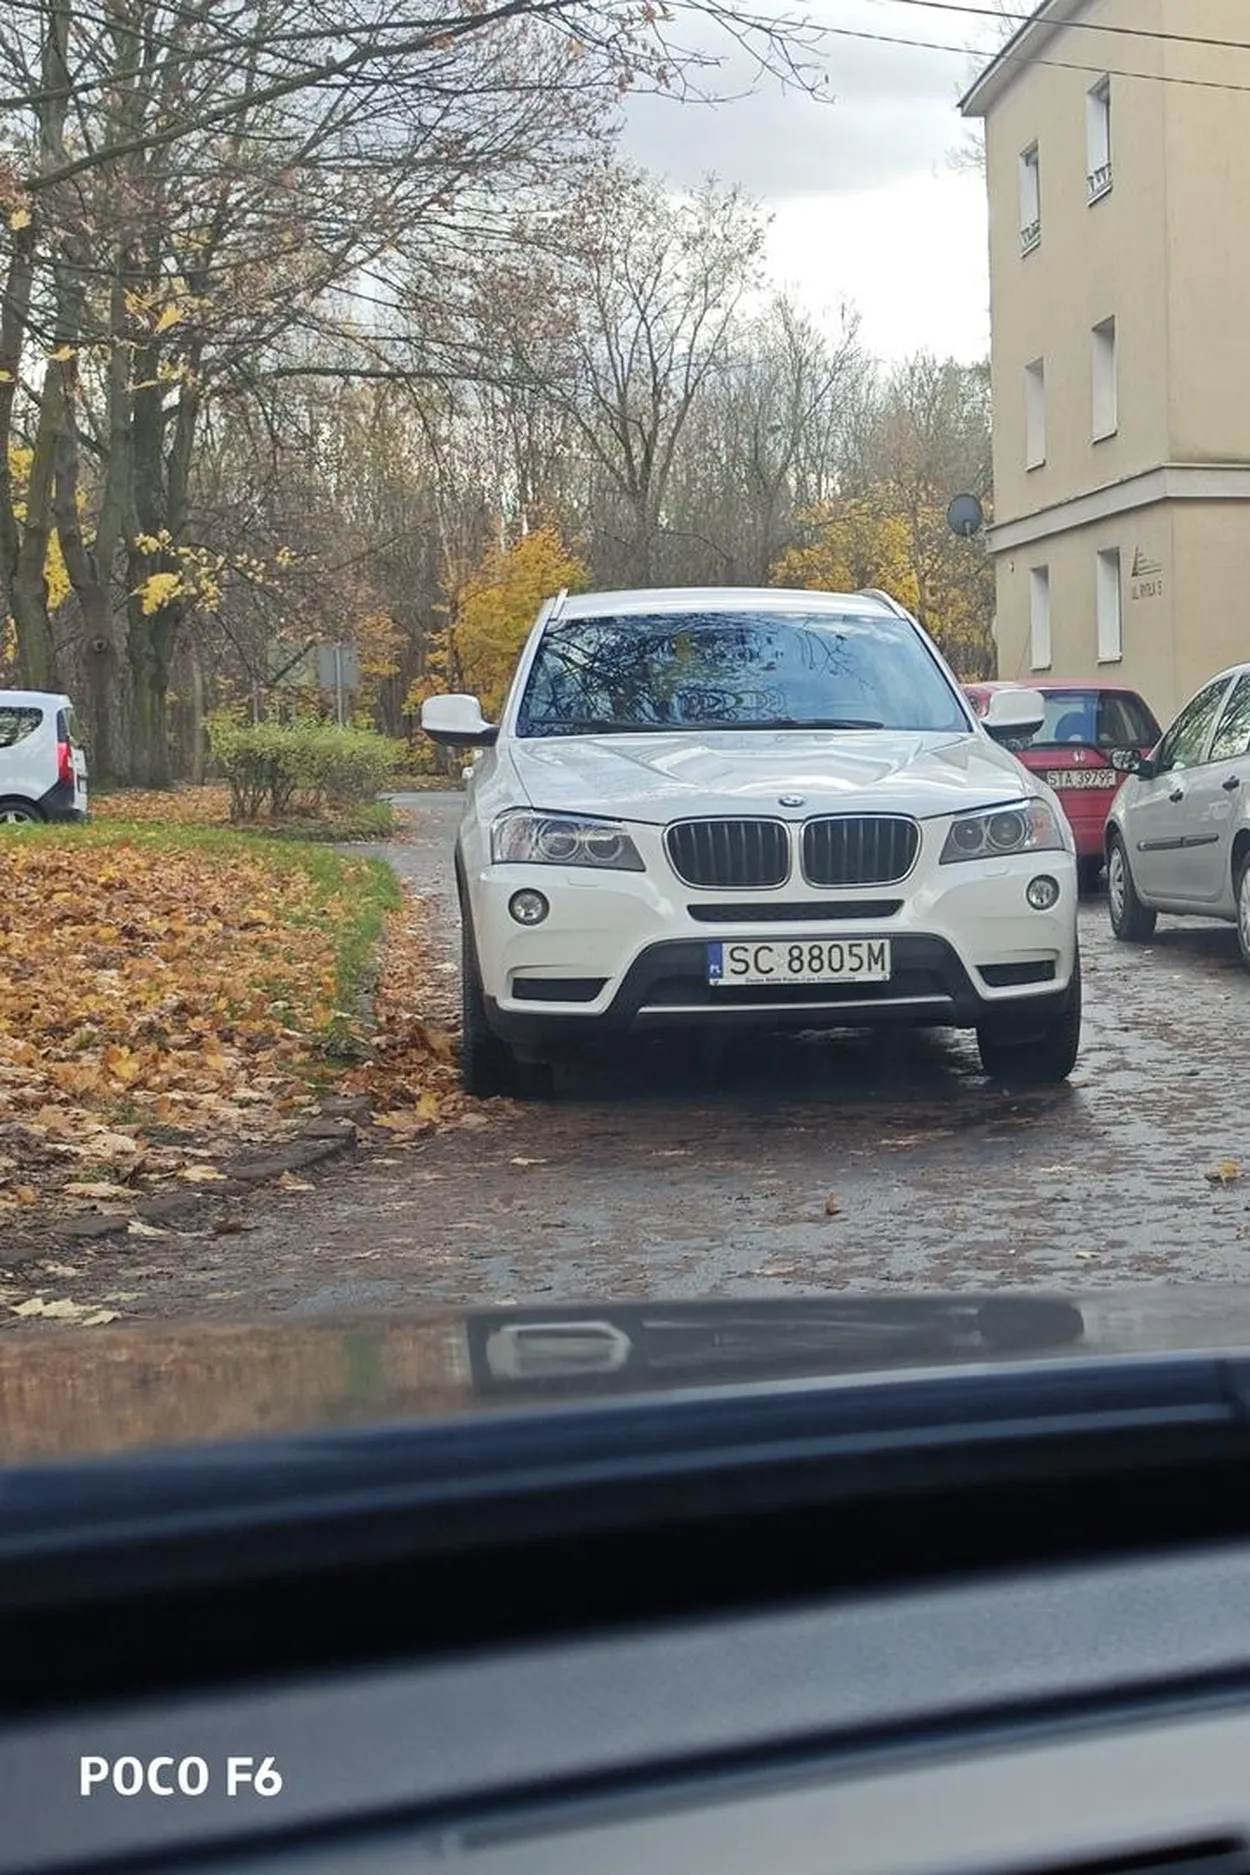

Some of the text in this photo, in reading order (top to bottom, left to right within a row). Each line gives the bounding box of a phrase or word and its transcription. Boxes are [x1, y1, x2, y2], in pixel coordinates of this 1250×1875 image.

[1048, 771, 1073, 787] STA
[729, 942, 886, 975] SC 8805M
